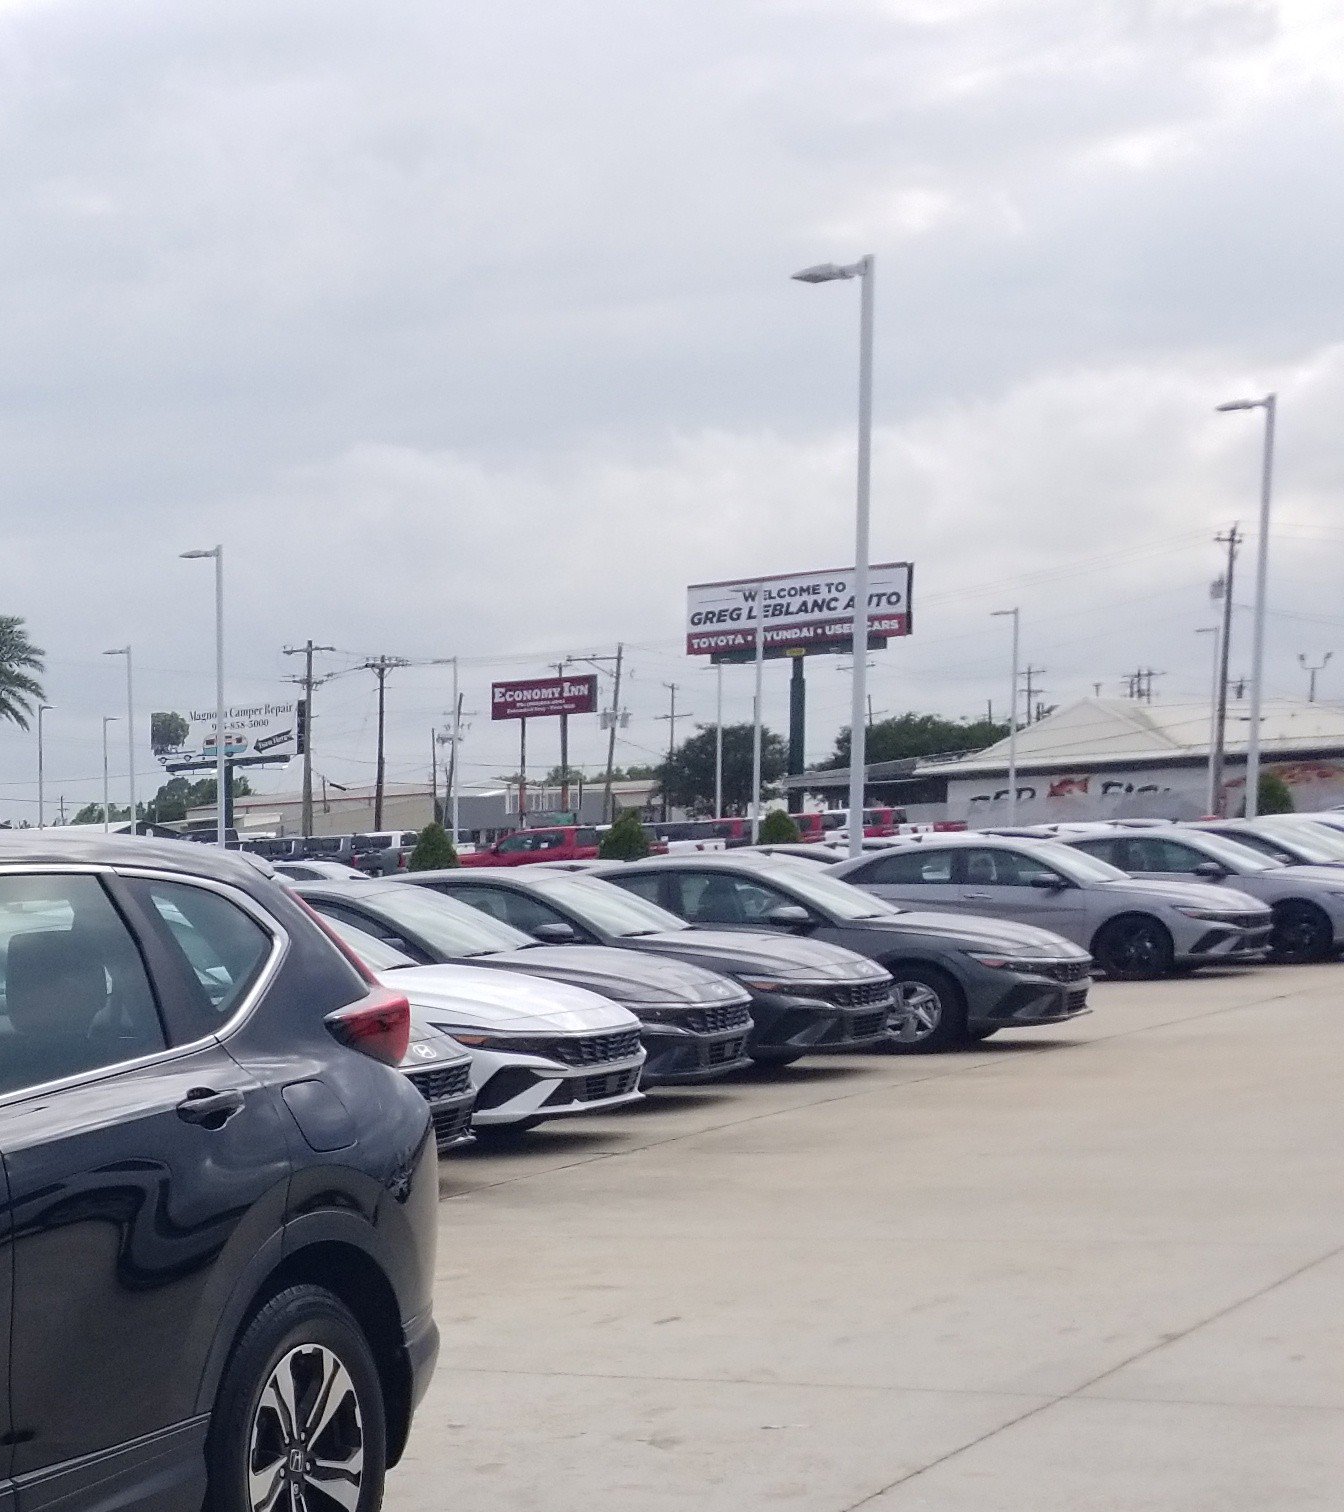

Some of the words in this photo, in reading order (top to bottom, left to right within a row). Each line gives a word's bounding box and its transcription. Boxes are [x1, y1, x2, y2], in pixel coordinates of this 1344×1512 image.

[741, 584, 821, 602] WELCOME
[825, 581, 847, 594] TO
[690, 606, 742, 626] GREG
[746, 596, 839, 620] LEBLANC
[692, 634, 745, 649] TOYOTA
[761, 626, 814, 641] YUNDAI
[825, 623, 854, 636] USE
[229, 706, 263, 719] Camper
[264, 703, 293, 717] Repair
